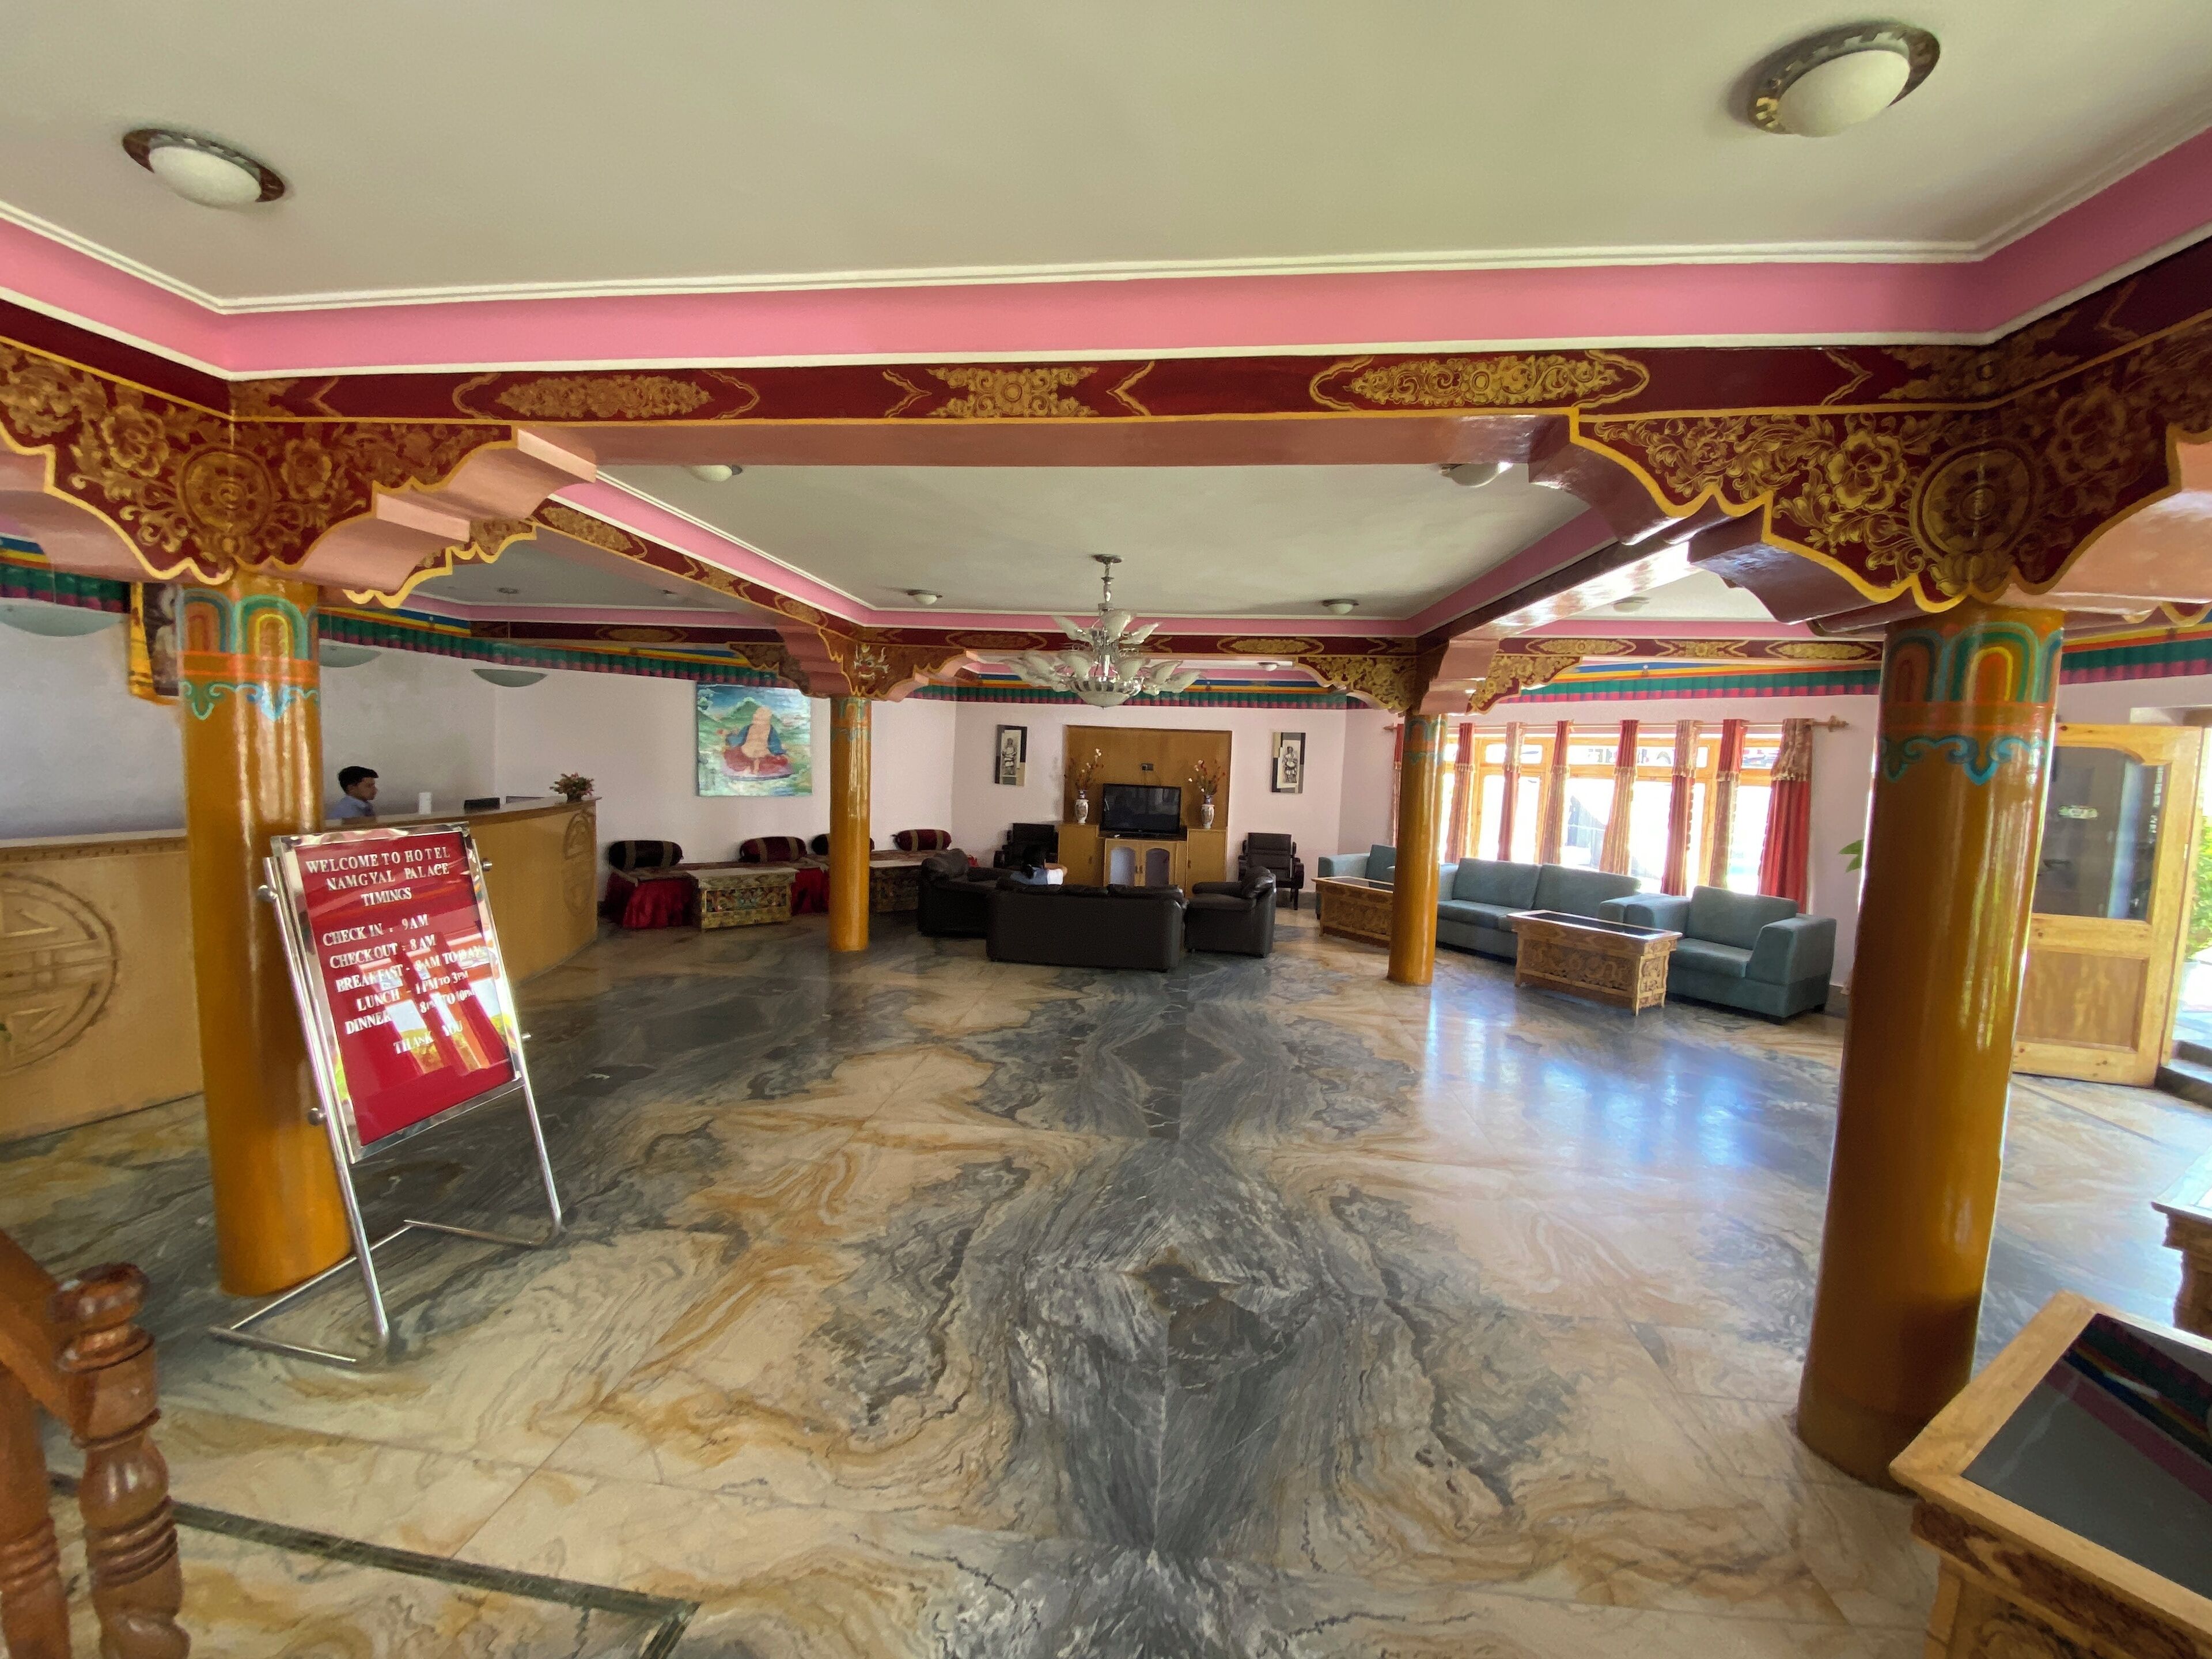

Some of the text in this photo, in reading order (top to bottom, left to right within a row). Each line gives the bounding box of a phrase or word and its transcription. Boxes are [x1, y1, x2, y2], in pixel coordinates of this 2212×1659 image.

[306, 847, 450, 873] WELCOME TO HOTEL
[326, 863, 449, 891] NAMGYAL PALACE
[361, 887, 412, 906] TIMINGS
[323, 926, 368, 946] CHECK
[369, 923, 384, 937] IN
[442, 952, 457, 964] TO
[356, 988, 400, 1012] LUNCH
[438, 976, 450, 985] TO
[393, 1031, 434, 1054] THANK
